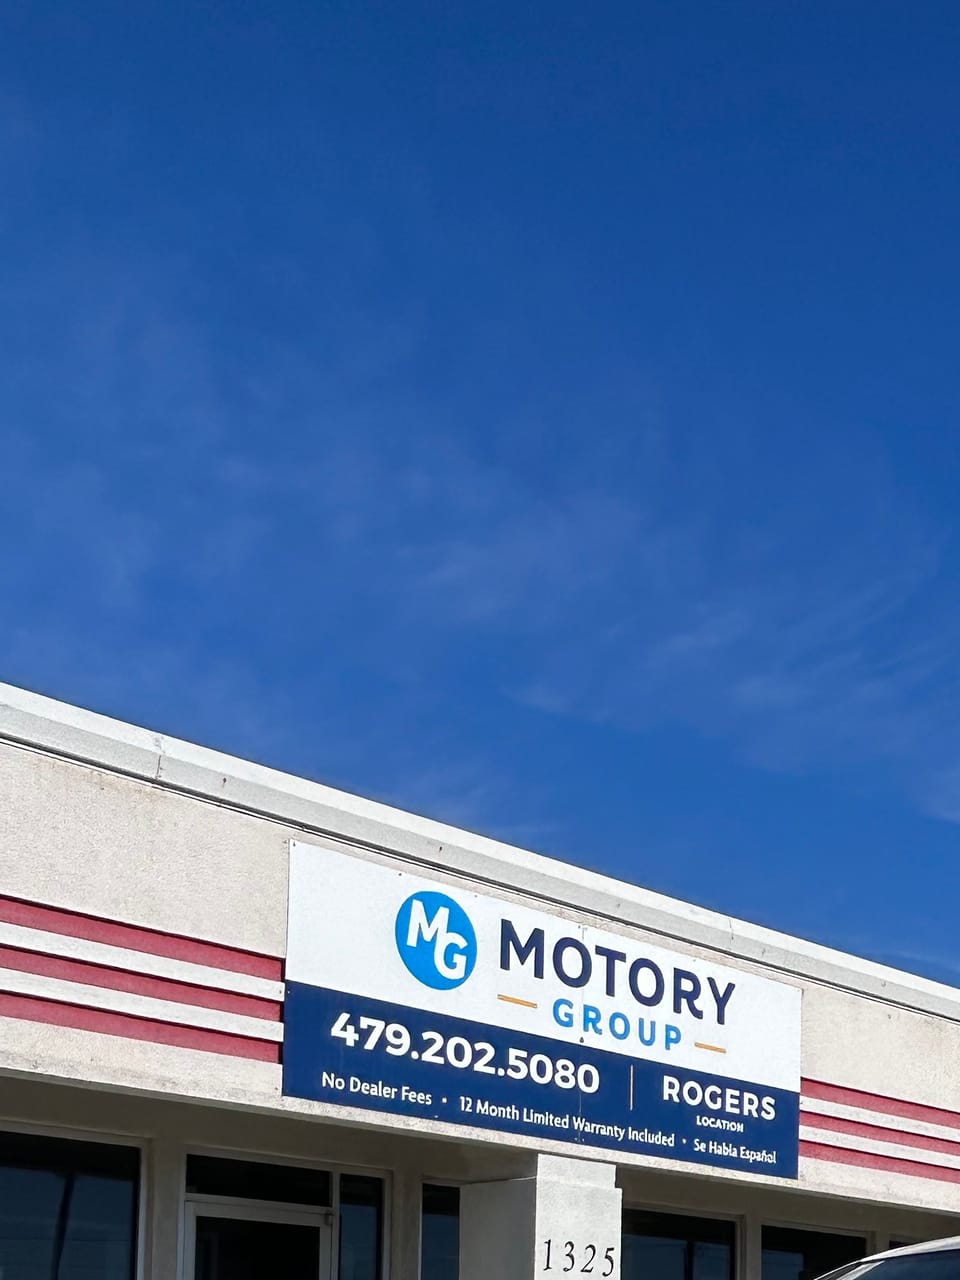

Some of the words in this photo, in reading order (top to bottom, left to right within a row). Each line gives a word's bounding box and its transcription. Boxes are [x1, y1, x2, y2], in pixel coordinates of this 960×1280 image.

[407, 899, 468, 980] MG
[500, 918, 736, 1025] MOTORY
[330, 1012, 600, 1094] 479.202.5080
[552, 998, 682, 1050] GROUP
[321, 1071, 345, 1090] No
[350, 1076, 397, 1100] Dealer
[402, 1086, 432, 1105] Fees
[460, 1096, 472, 1113] 12
[476, 1099, 520, 1121] Month
[523, 1107, 569, 1129] Limited
[573, 1116, 626, 1140] Warranty
[628, 1126, 675, 1147] Included
[694, 1138, 707, 1152] Se
[709, 1141, 738, 1157] Habla
[740, 1147, 777, 1164] Español
[662, 1075, 776, 1121] ROGERS
[696, 1115, 744, 1133] LOCATION
[543, 1239, 614, 1277] 1325
